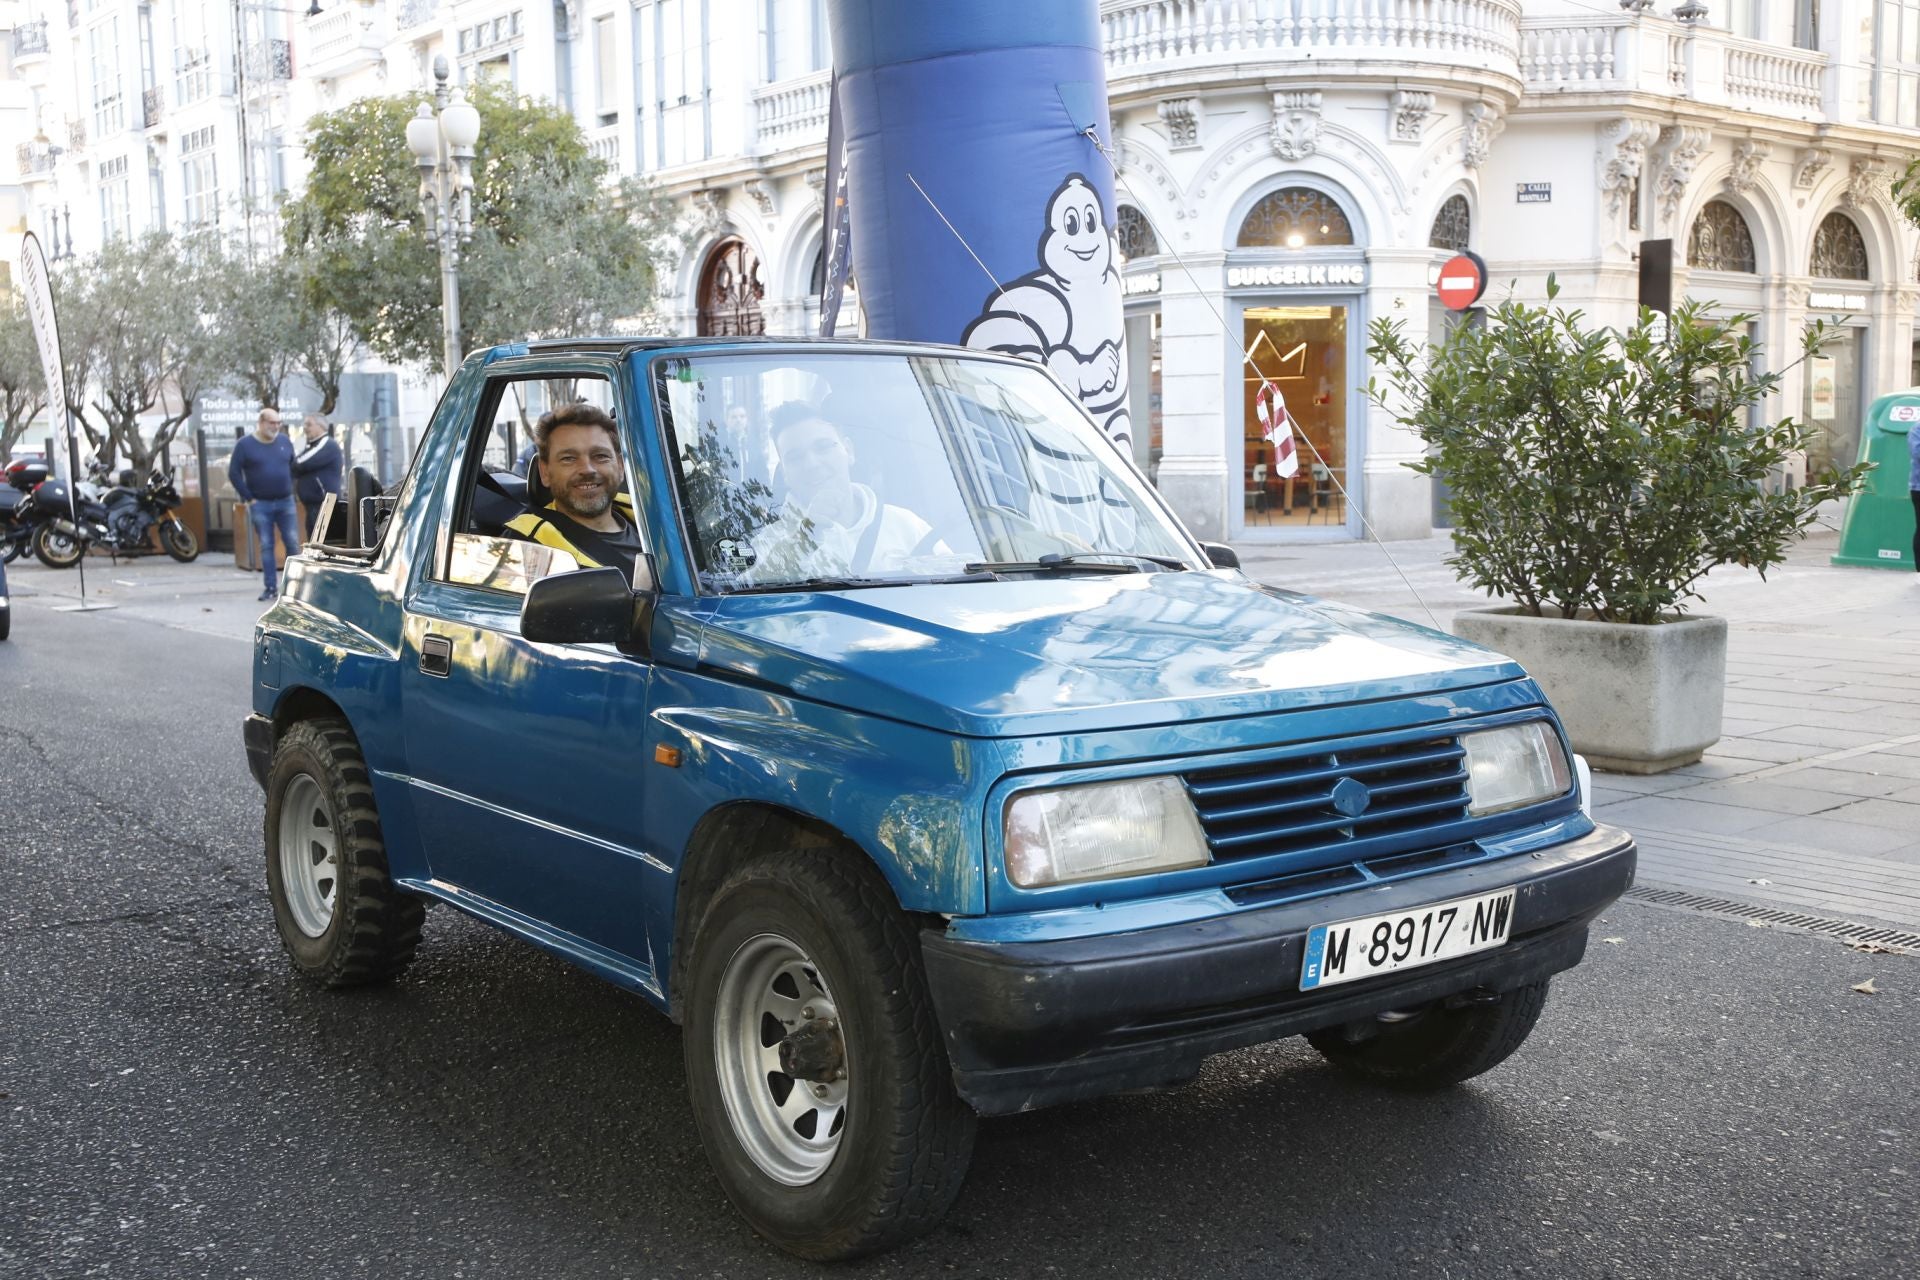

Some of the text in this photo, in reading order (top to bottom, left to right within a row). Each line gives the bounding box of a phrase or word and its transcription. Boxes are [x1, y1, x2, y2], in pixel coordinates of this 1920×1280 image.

[1528, 183, 1551, 191] CALLE
[1519, 193, 1550, 202] MANTILLA
[1227, 264, 1364, 286] BURGER KING
[200, 398, 229, 409] Todo
[201, 410, 245, 422] cuando
[1323, 893, 1513, 977] M 8917 NW
[1308, 963, 1318, 978] E
